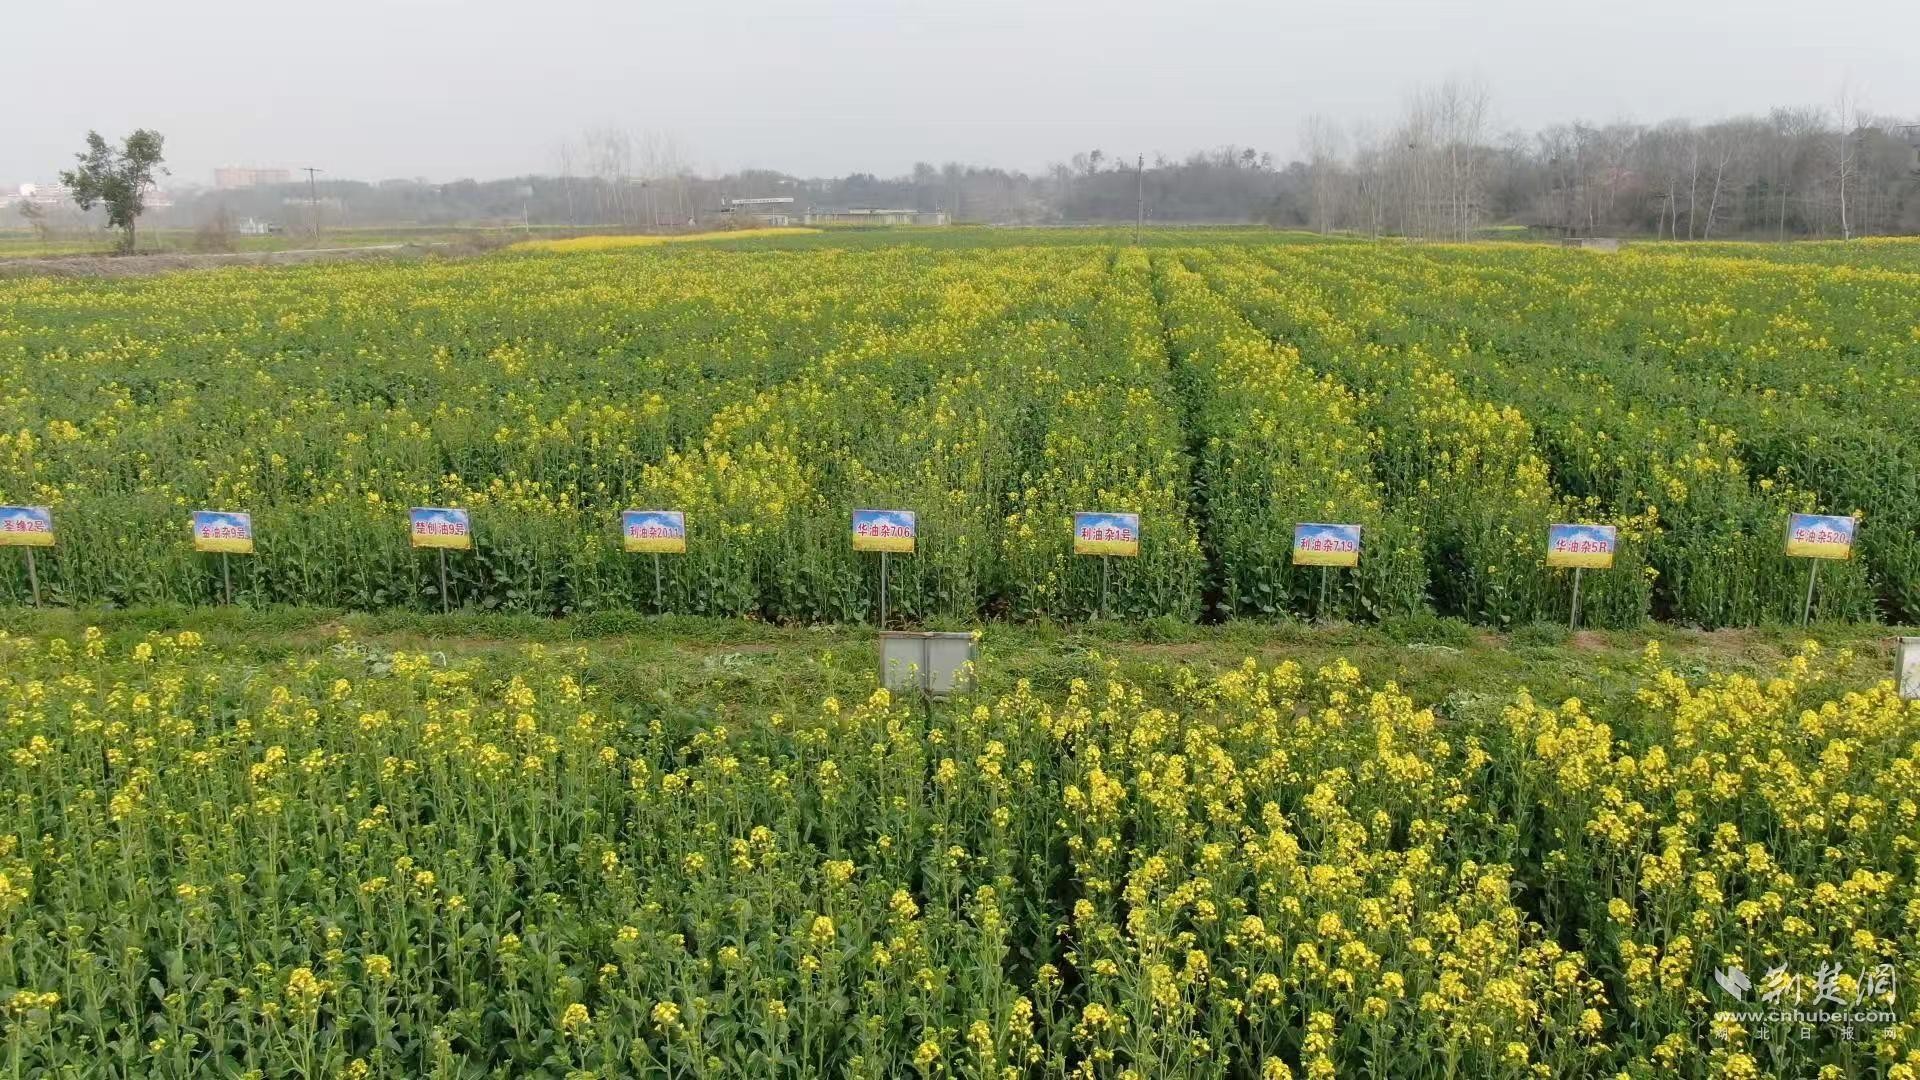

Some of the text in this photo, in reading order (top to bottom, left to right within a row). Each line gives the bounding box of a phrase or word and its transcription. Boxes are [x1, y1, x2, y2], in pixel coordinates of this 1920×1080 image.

[416, 521, 464, 536] 楚创油9号
[630, 526, 678, 539] 利油杂2011
[857, 523, 910, 538] 华油杂706
[1081, 528, 1131, 542] 利油杂1号
[1795, 528, 1846, 544] 华油杂520
[1300, 538, 1353, 552] 利油杂719
[1556, 538, 1607, 553] 华油杂5R
